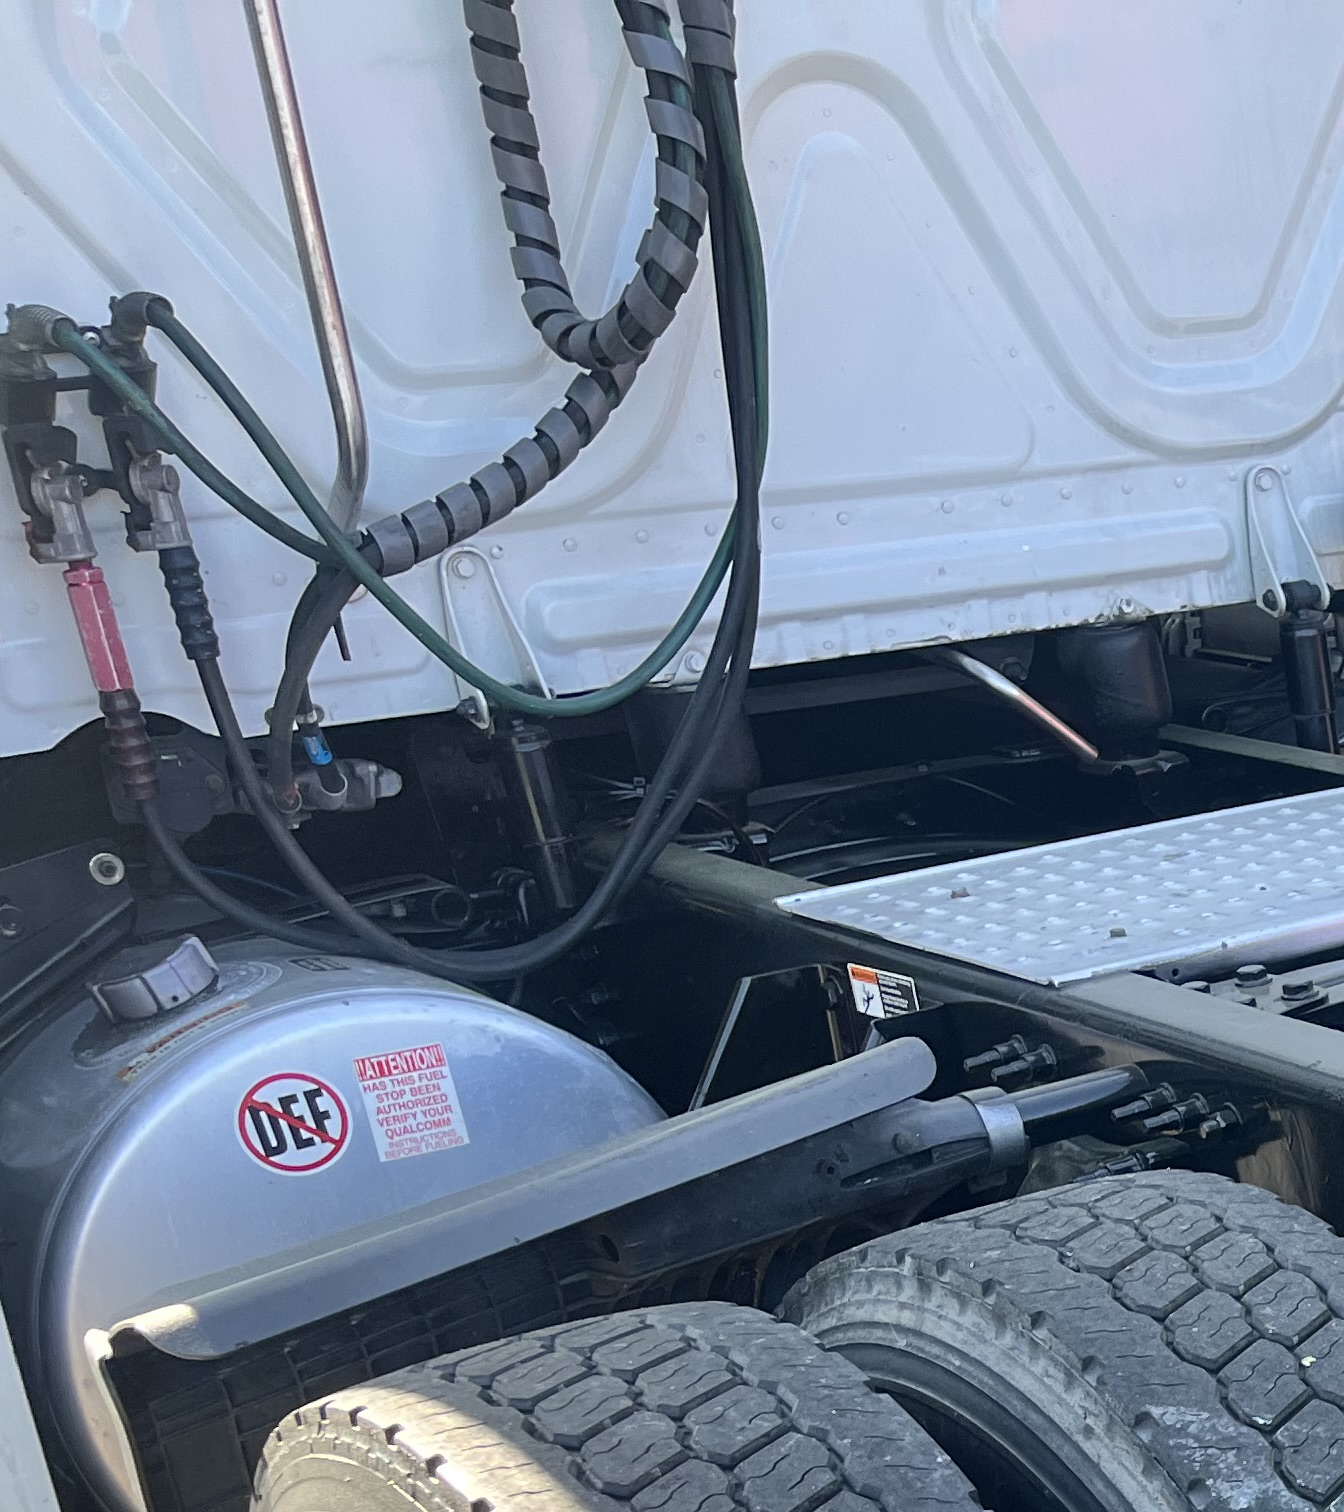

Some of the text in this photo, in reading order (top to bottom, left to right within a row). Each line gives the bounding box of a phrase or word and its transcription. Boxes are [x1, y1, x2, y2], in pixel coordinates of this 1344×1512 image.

[362, 1070, 448, 1094] HAS THIS FUEL
[376, 1082, 441, 1104] STOP BEEN
[376, 1093, 449, 1116] AUTHORIZED
[376, 1104, 453, 1128] VERIFY YOUR
[248, 1087, 331, 1157] DEF
[385, 1117, 452, 1140] QUALCOMM
